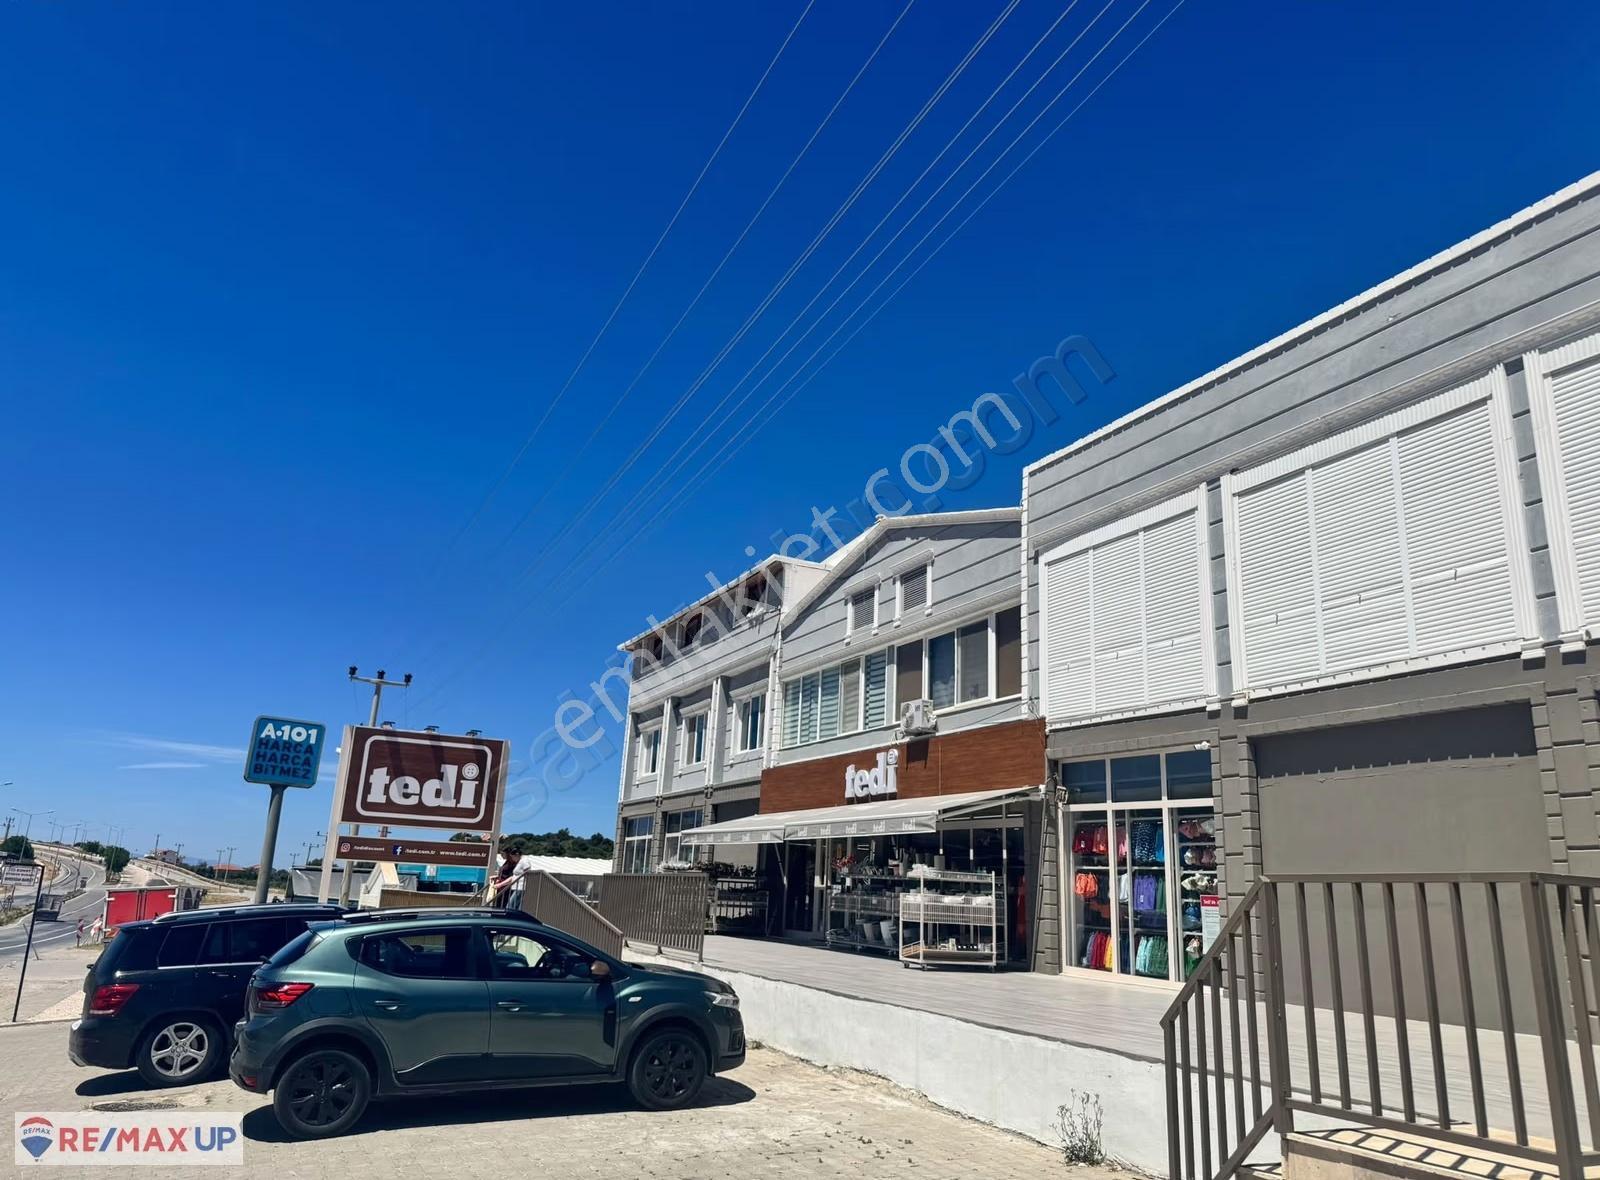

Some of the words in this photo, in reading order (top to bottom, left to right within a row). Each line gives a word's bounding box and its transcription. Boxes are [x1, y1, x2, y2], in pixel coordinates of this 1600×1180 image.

[258, 738, 314, 756] HARCA
[255, 751, 312, 767] HARCA
[845, 748, 899, 798] tedi
[367, 762, 480, 808] tedi
[440, 850, 487, 858] www.tedi.com.tr
